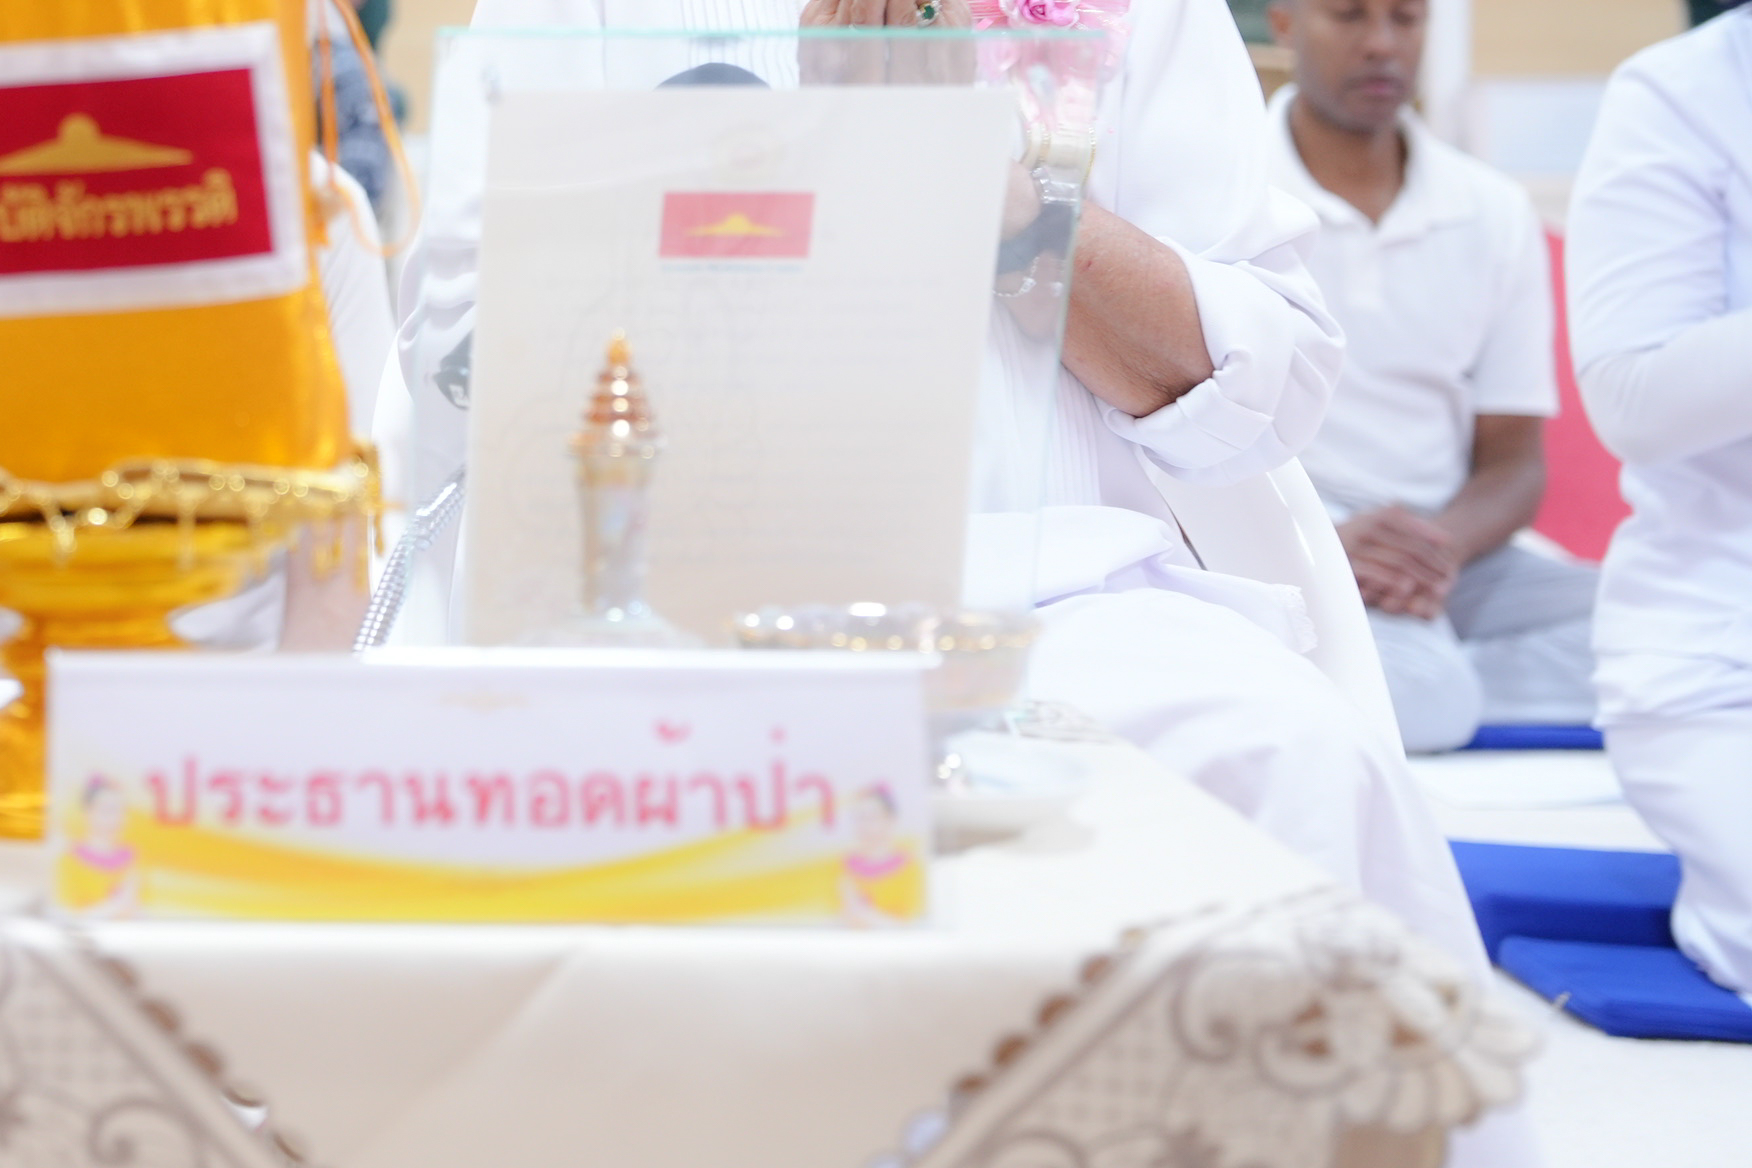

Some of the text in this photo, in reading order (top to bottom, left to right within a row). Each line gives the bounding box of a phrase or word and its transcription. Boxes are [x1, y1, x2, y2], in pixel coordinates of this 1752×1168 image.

[141, 717, 837, 830] ประธานทอดผ้าป่า
